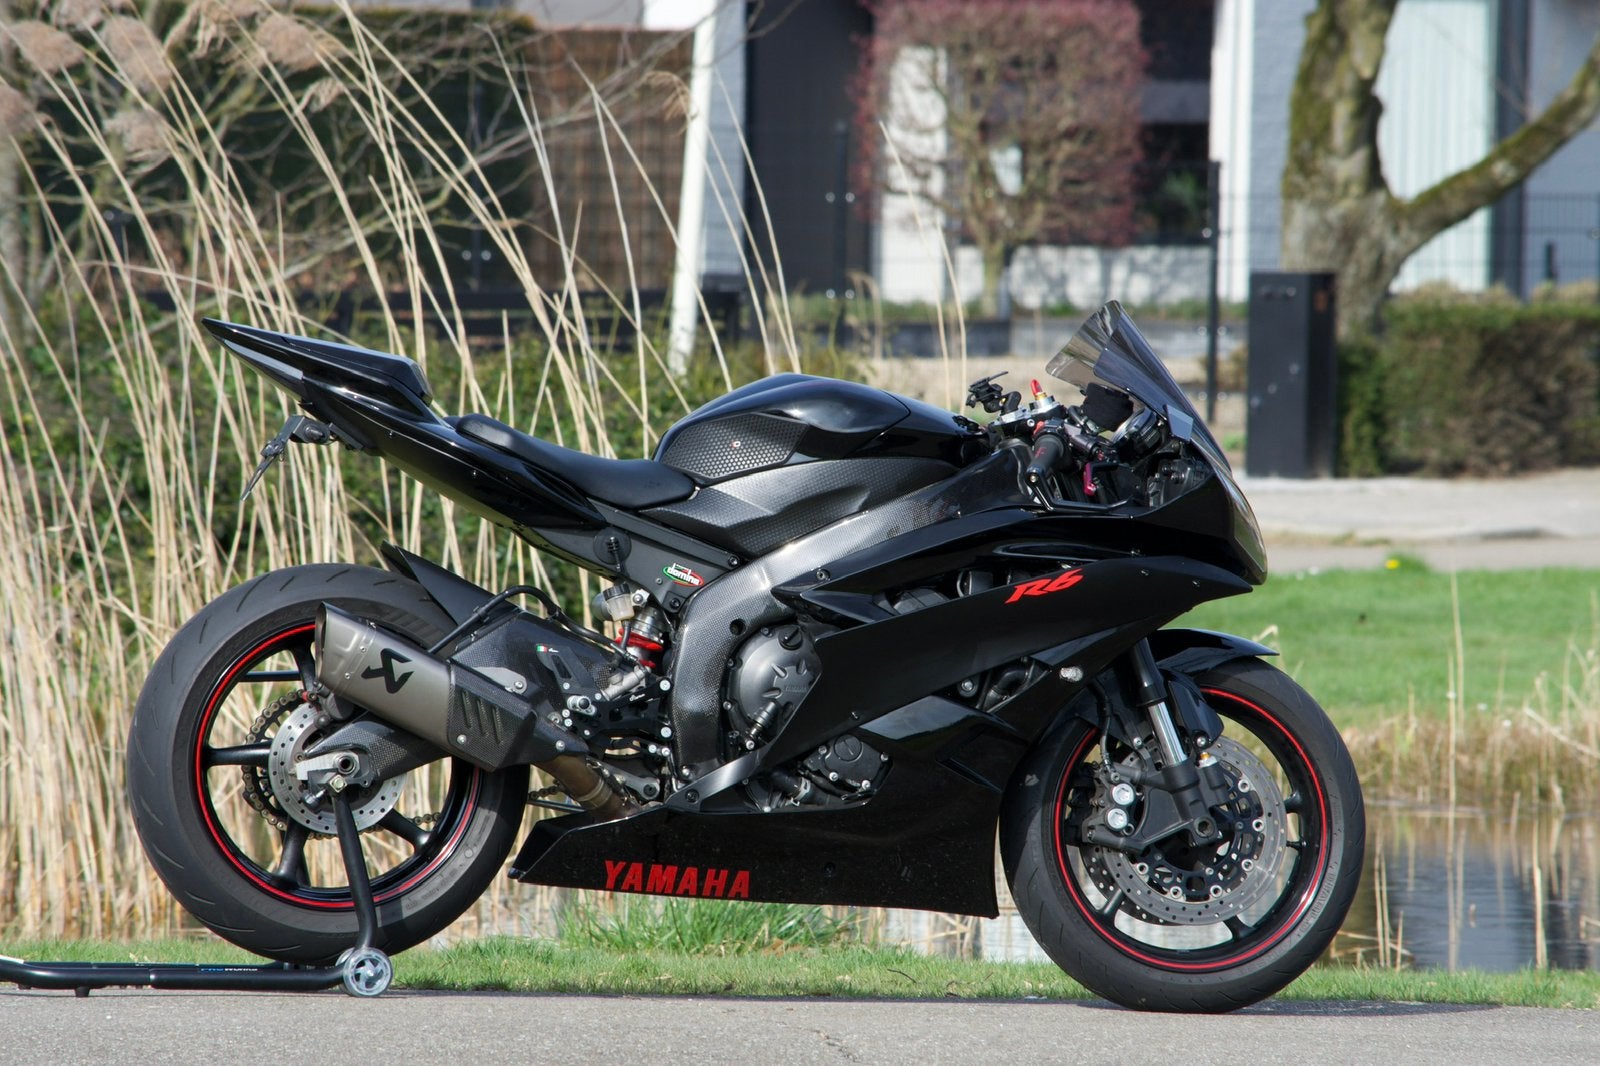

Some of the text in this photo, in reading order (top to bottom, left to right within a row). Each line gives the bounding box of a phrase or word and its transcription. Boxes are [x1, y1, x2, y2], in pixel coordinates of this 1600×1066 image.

[667, 562, 700, 586] domino
[1004, 568, 1084, 604] R6
[604, 860, 750, 898] YAMAHA
